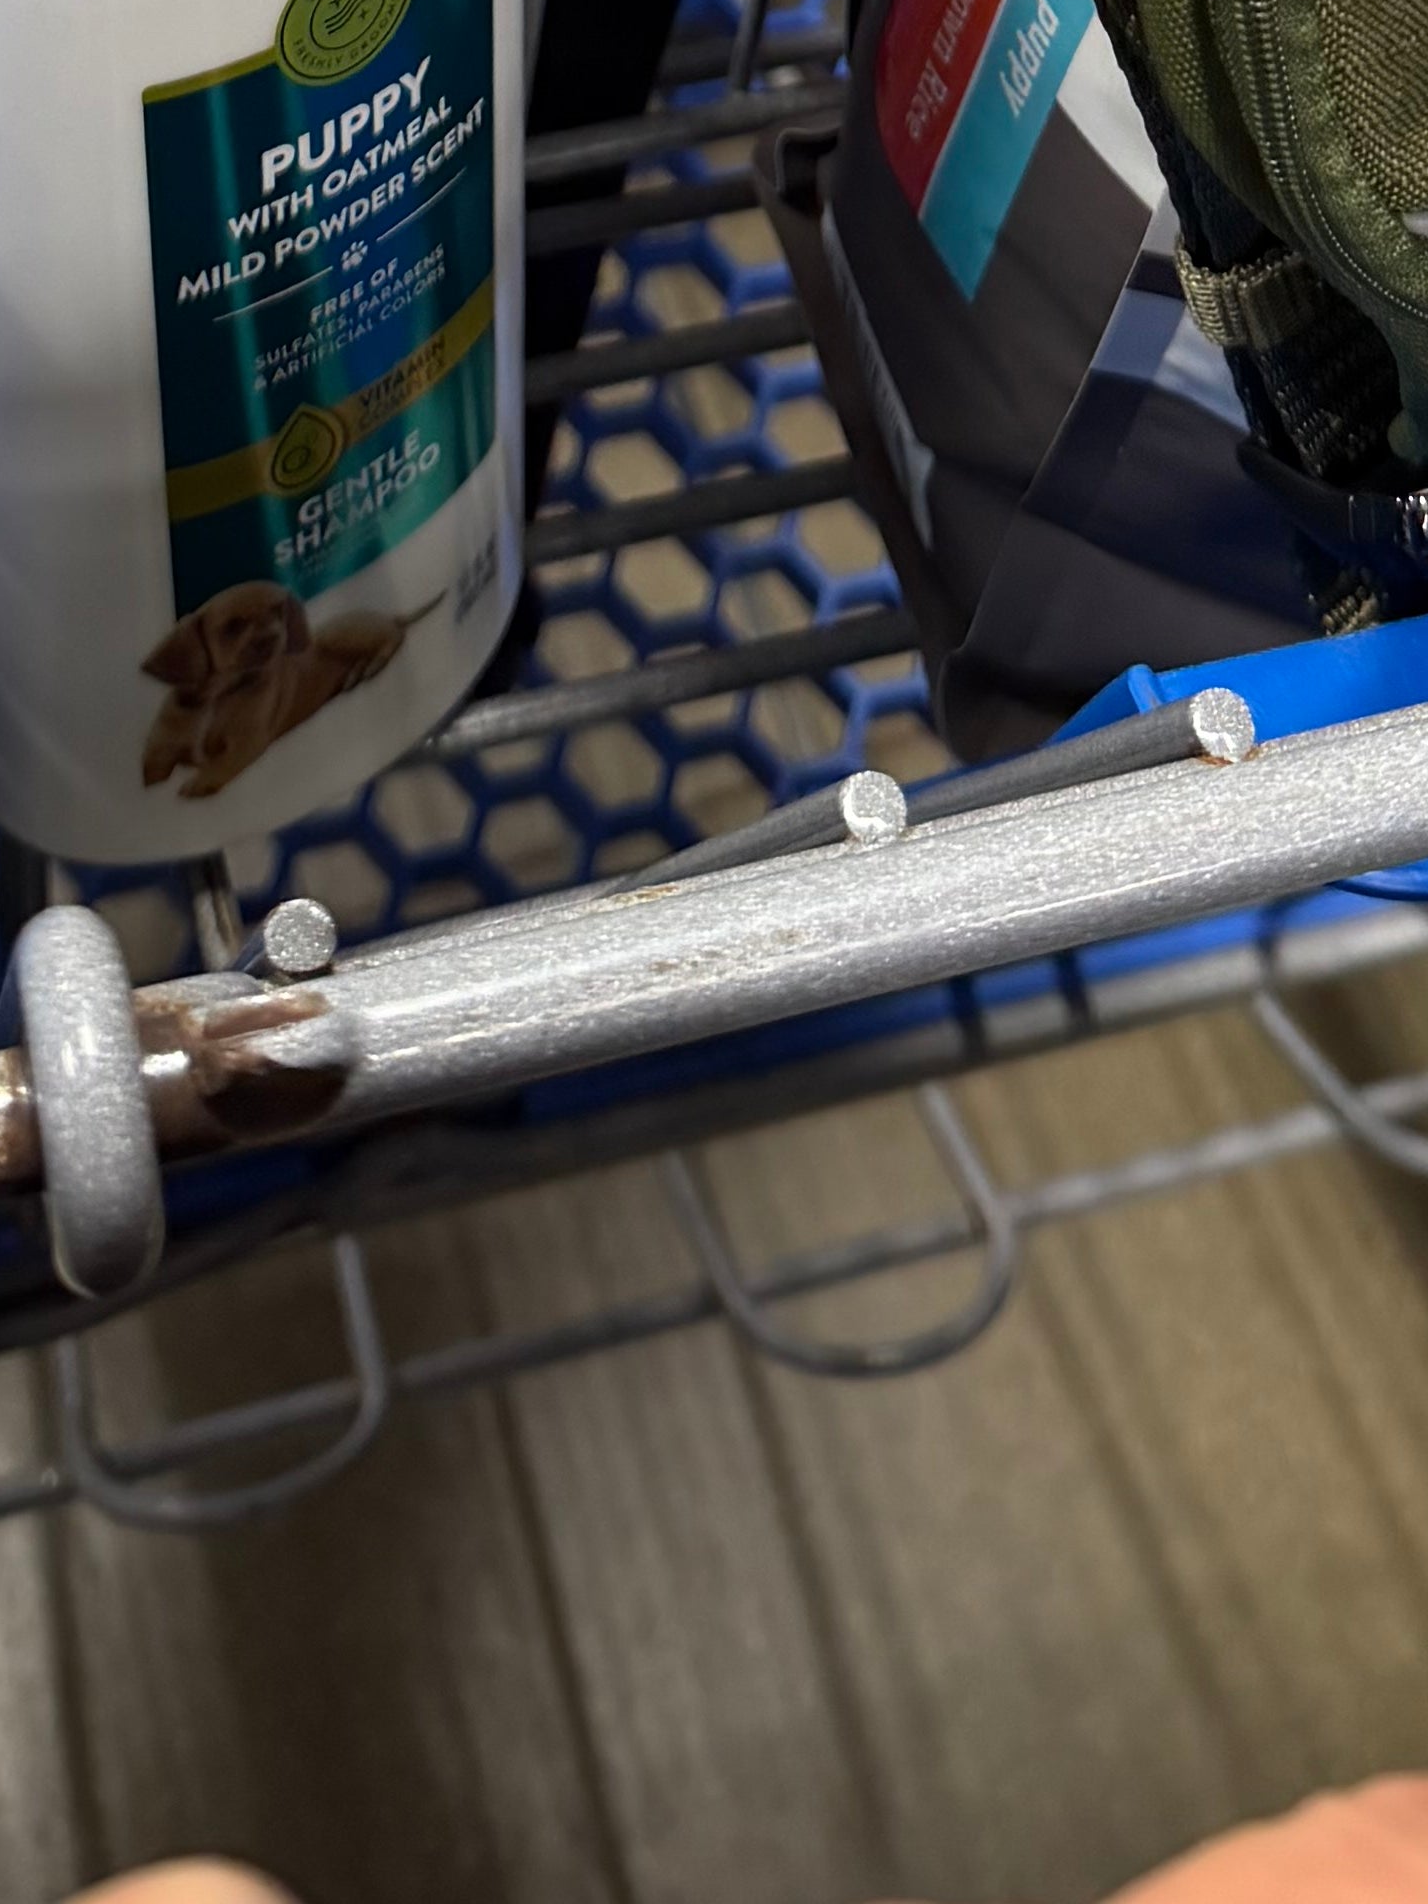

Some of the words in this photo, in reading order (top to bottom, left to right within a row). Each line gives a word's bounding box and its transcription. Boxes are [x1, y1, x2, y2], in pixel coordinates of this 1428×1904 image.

[261, 56, 430, 195] PUPPY
[905, 57, 948, 140] Rice
[176, 250, 266, 304] MILD
[274, 172, 405, 267] POWDER
[411, 96, 485, 185] SCENT
[228, 183, 315, 241] WITH
[321, 95, 452, 198] OATMEAL
[272, 320, 373, 384] ARTIFICIAL
[380, 261, 446, 321] COLORS
[309, 280, 365, 326] FREE
[371, 257, 399, 287] OF
[358, 243, 446, 317] PARABENS
[360, 333, 447, 406] VITAMIN
[274, 443, 440, 565] SHAMPOO
[298, 429, 420, 525] GENTLE
